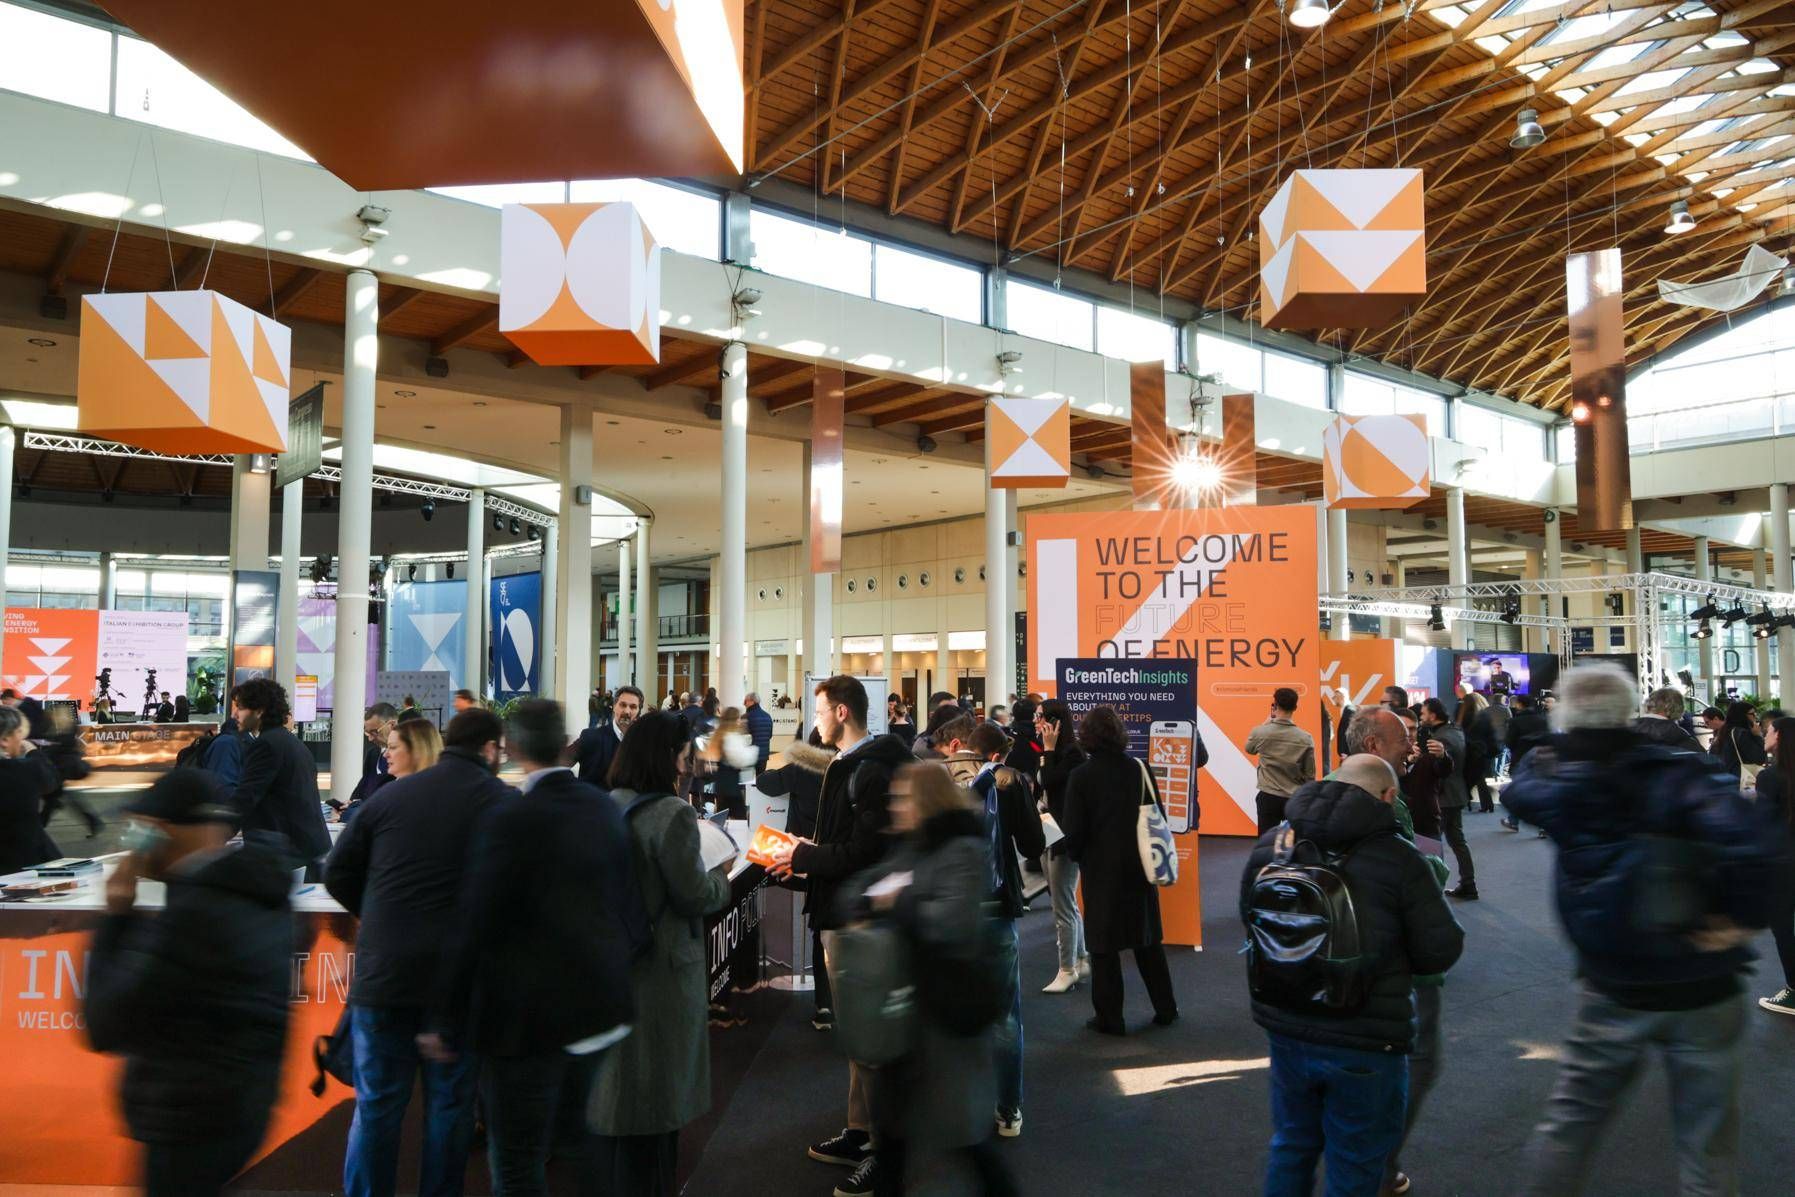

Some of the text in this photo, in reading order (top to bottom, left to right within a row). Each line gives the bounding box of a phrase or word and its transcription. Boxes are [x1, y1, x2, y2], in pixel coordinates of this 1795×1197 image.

[1095, 532, 1289, 566] WELCOME
[1095, 569, 1228, 600] TO THE
[1095, 602, 1247, 635] FUTURE
[1152, 638, 1306, 668] ENERGY
[1724, 649, 1740, 674] D
[1065, 667, 1189, 687] GreenTechInsights
[1066, 692, 1175, 701] EVERYTHING YOU NEED
[1118, 703, 1131, 711] AT
[1118, 713, 1152, 722] ERTIPS
[95, 730, 130, 741] MAIN
[711, 906, 739, 974] INFO
[18, 949, 90, 999] IN
[18, 1011, 87, 1030] WELCO
